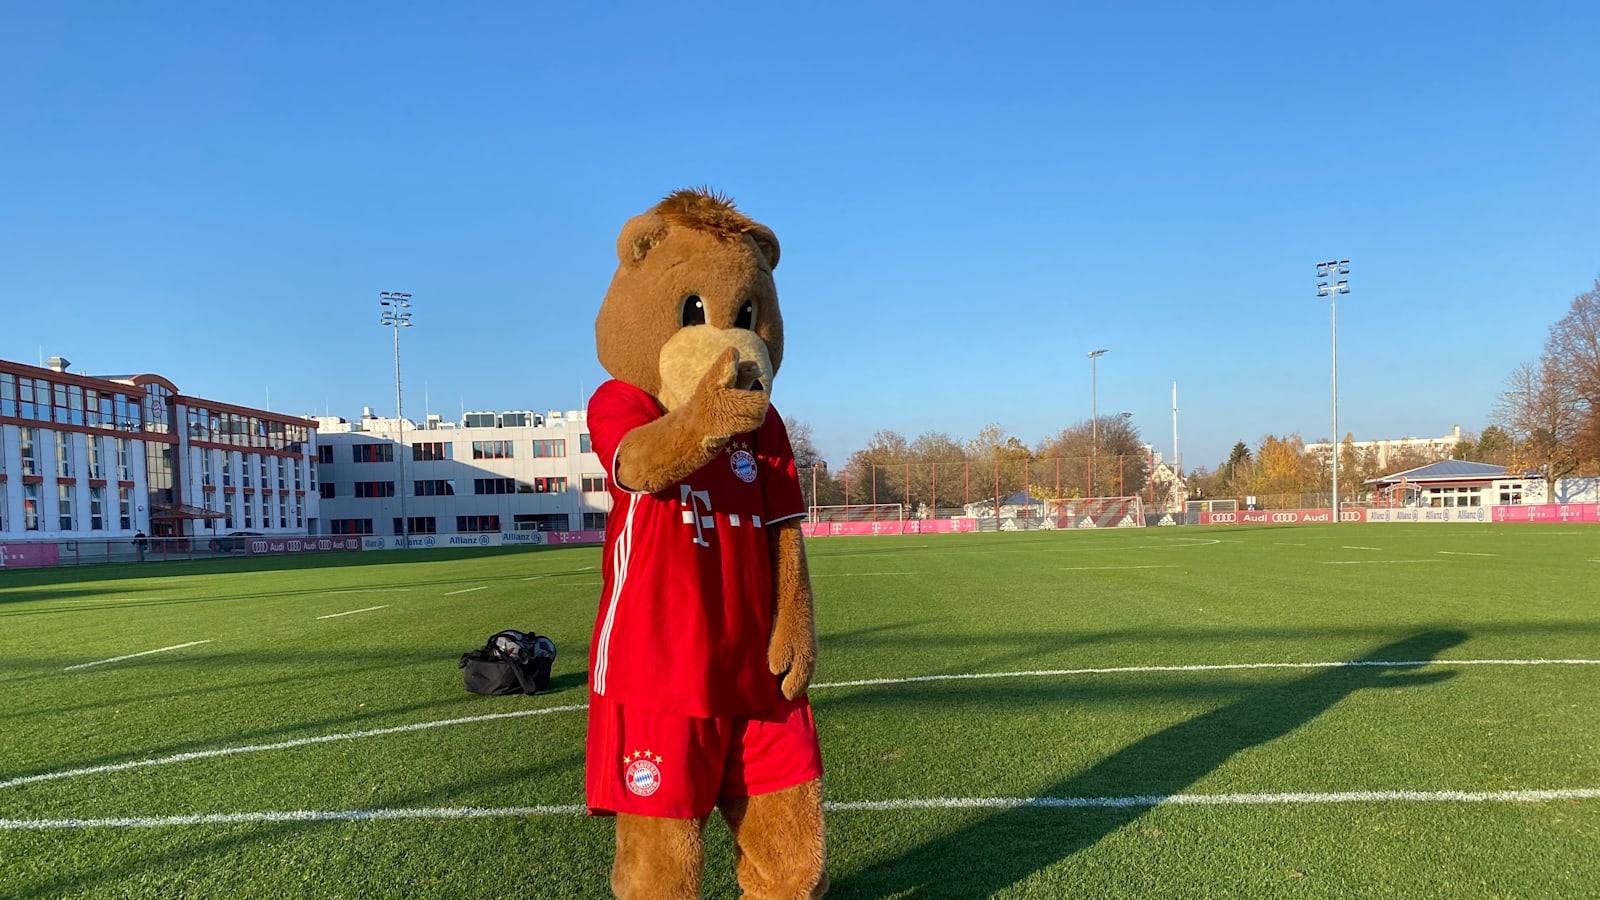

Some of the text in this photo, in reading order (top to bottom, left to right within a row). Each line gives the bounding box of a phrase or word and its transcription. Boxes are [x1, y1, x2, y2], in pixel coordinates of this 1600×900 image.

[680, 484, 712, 548] T
[1243, 513, 1329, 522] Audi Audi
[1396, 511, 1412, 520] Allianz
[1425, 511, 1442, 520] Allianz
[1457, 510, 1477, 519] Allianz
[503, 533, 530, 541] Allianz
[270, 541, 344, 551] Audi Audi Audi
